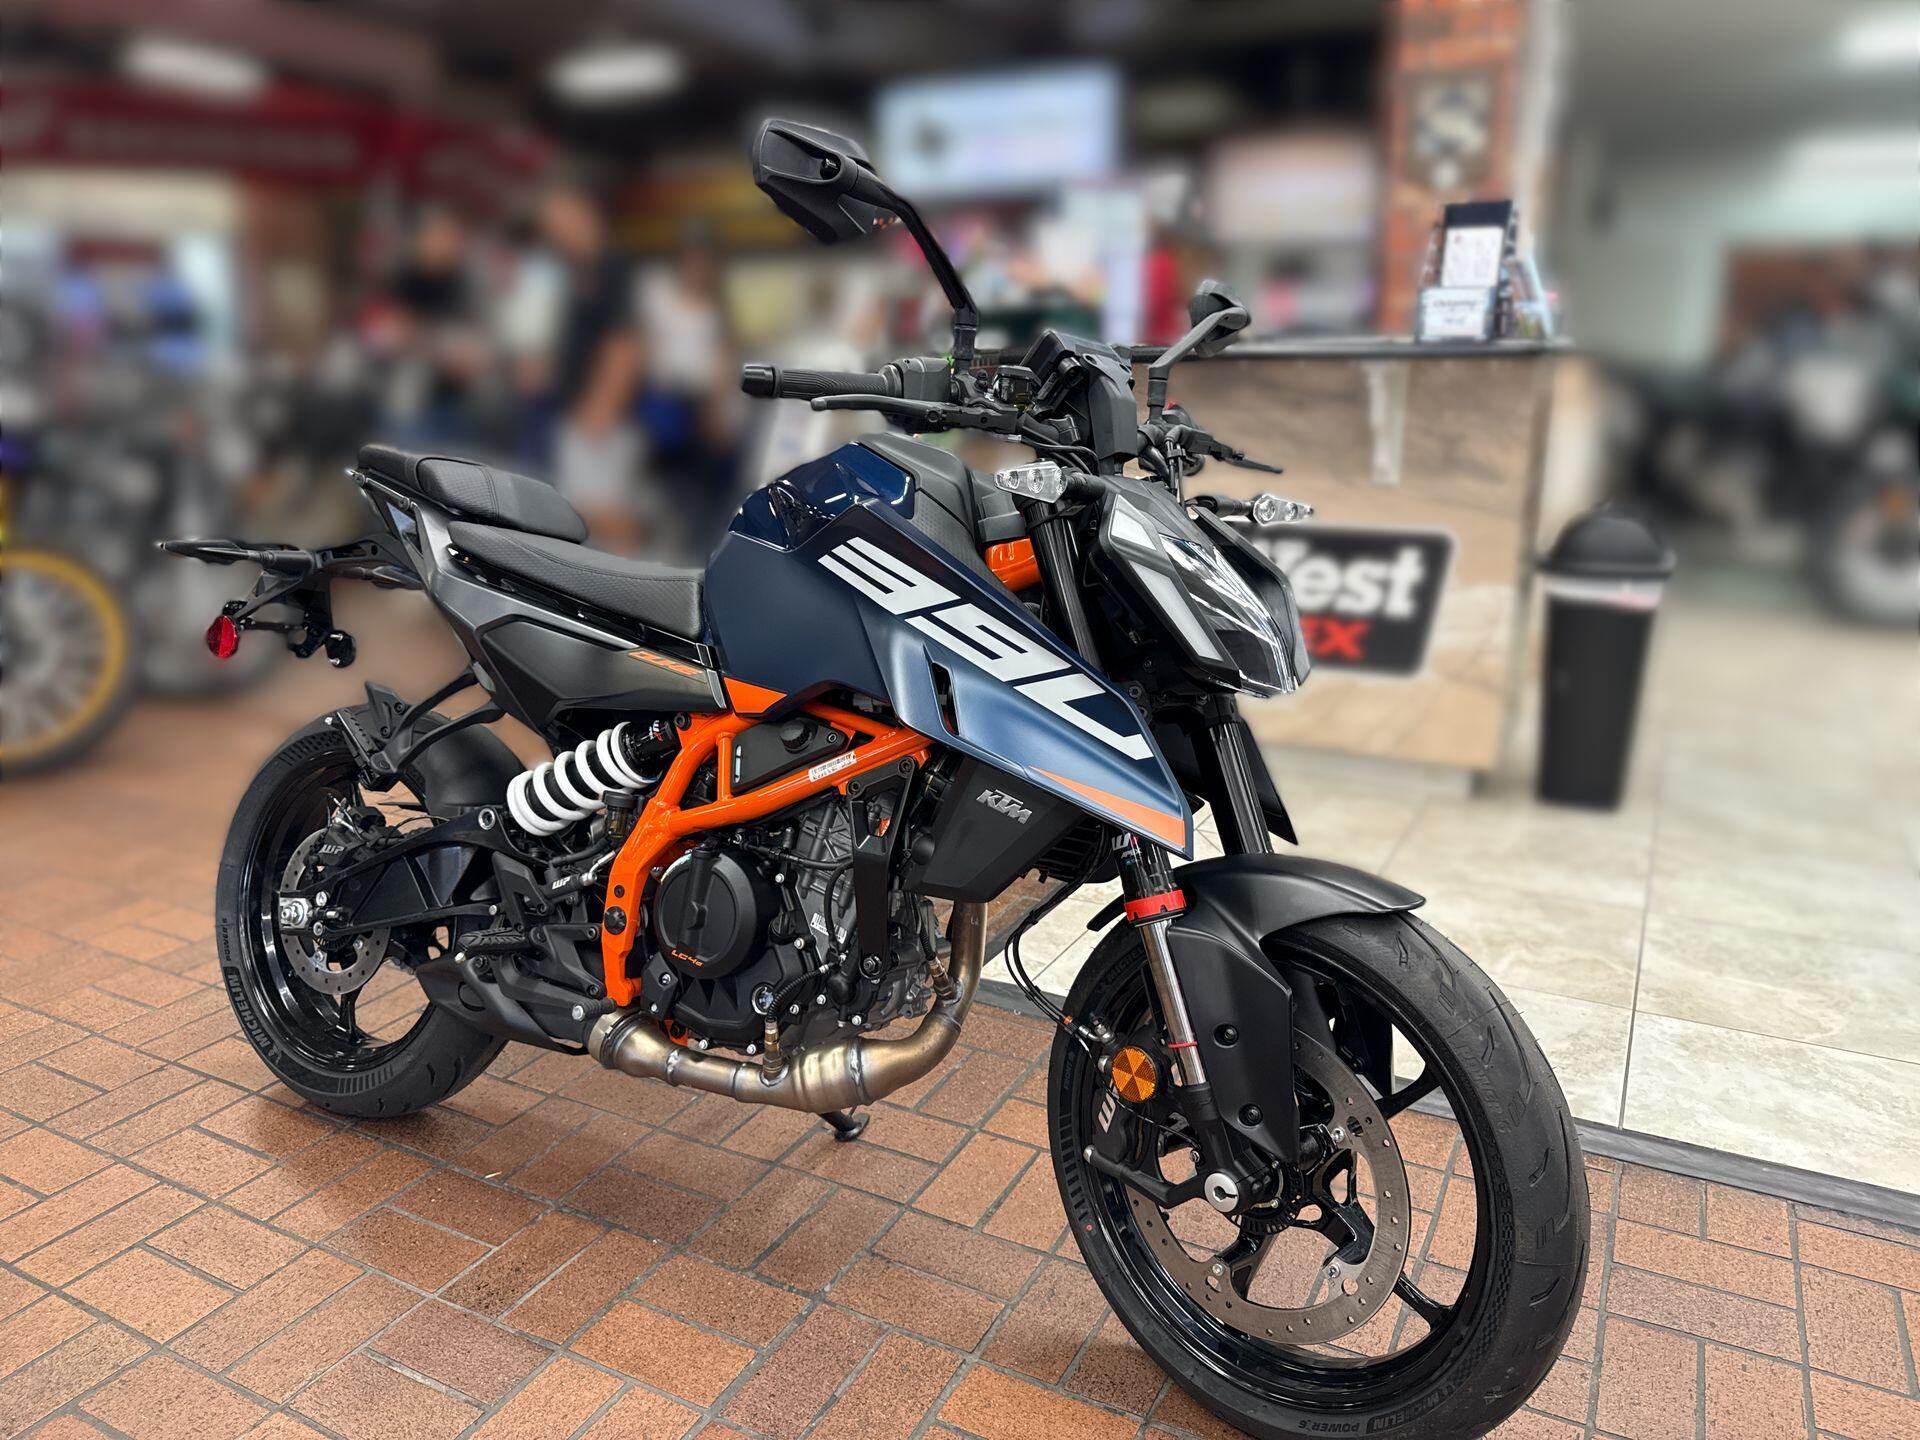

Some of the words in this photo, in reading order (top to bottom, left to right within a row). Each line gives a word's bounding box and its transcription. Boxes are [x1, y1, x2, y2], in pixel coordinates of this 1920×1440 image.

[976, 789, 1033, 825] KTM
[318, 844, 345, 855] WP
[551, 875, 571, 890] WP
[228, 974, 271, 1048] MICHELIN
[1298, 1419, 1308, 1428] 6
[1312, 1421, 1360, 1433] POWER
